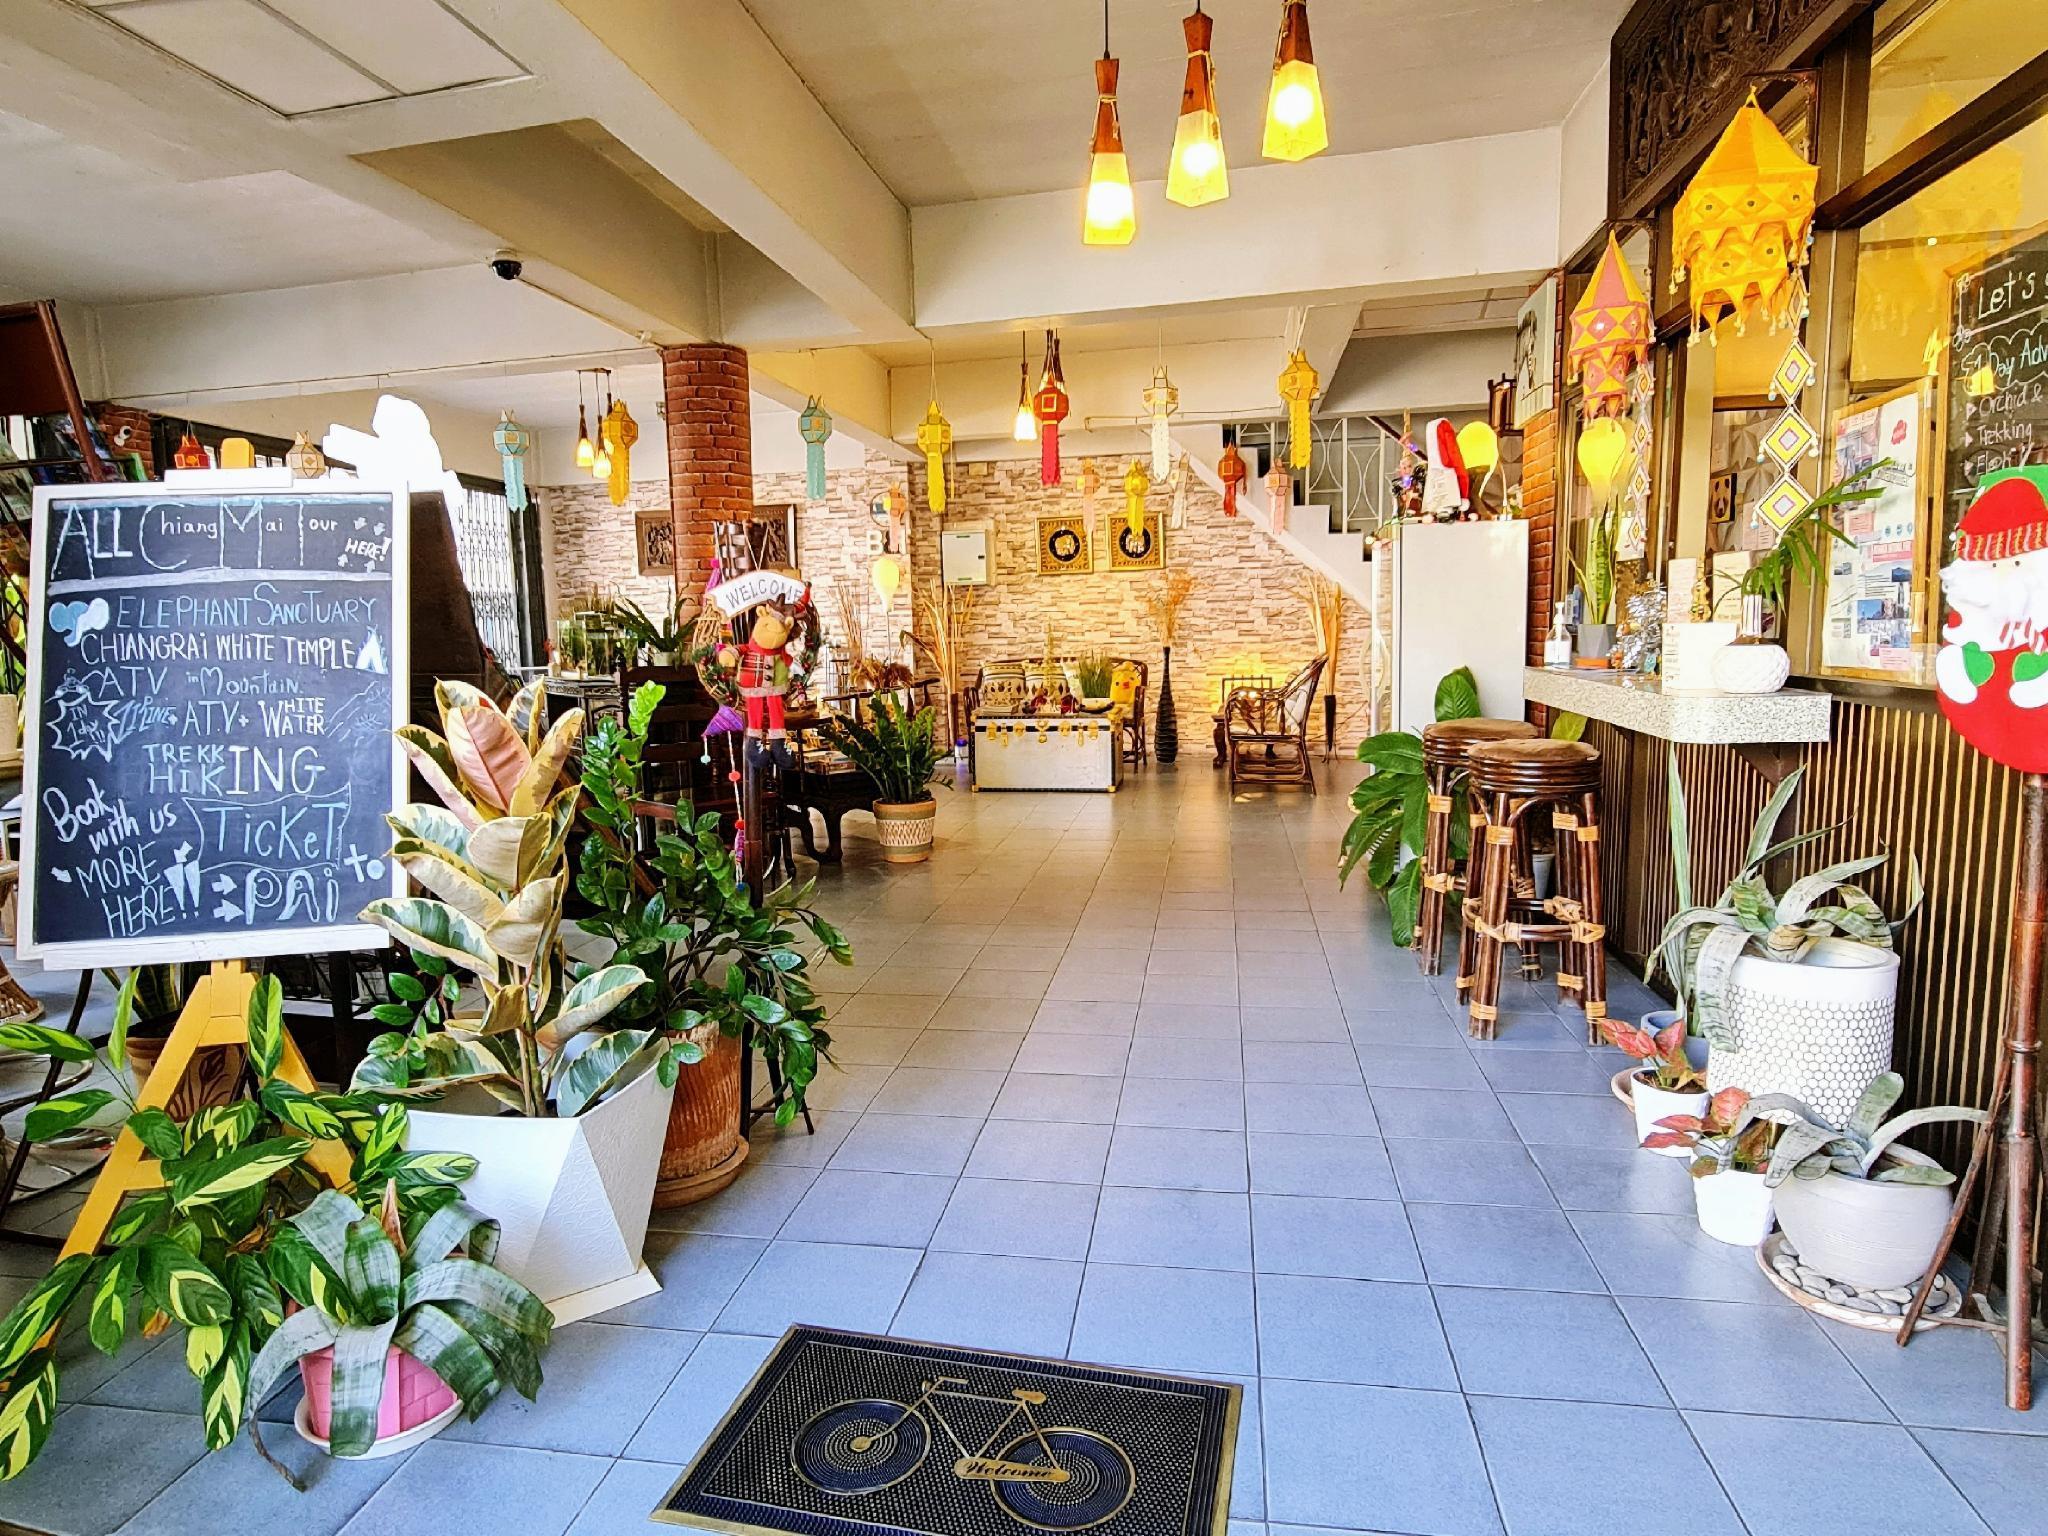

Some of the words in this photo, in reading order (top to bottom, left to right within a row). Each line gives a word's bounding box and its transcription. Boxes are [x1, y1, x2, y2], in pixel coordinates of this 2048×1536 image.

[1978, 270, 2035, 319] Let's
[1979, 383, 2028, 418] Orchid
[2031, 382, 2043, 402] &
[1976, 420, 2032, 446] Trekking
[50, 503, 133, 580] ALL
[140, 503, 217, 570] Chiang
[218, 497, 283, 569] Mai
[345, 536, 392, 562] HERE!
[117, 595, 251, 629] ELEPHANT
[253, 582, 377, 625] SANCTUARY
[725, 579, 803, 609] WELCOME
[281, 636, 355, 671] TEMPLE
[98, 666, 168, 698] ATV
[185, 671, 200, 684] in
[43, 777, 114, 843] Book
[88, 799, 141, 855] with
[149, 802, 178, 834] us
[75, 841, 161, 898] MORE
